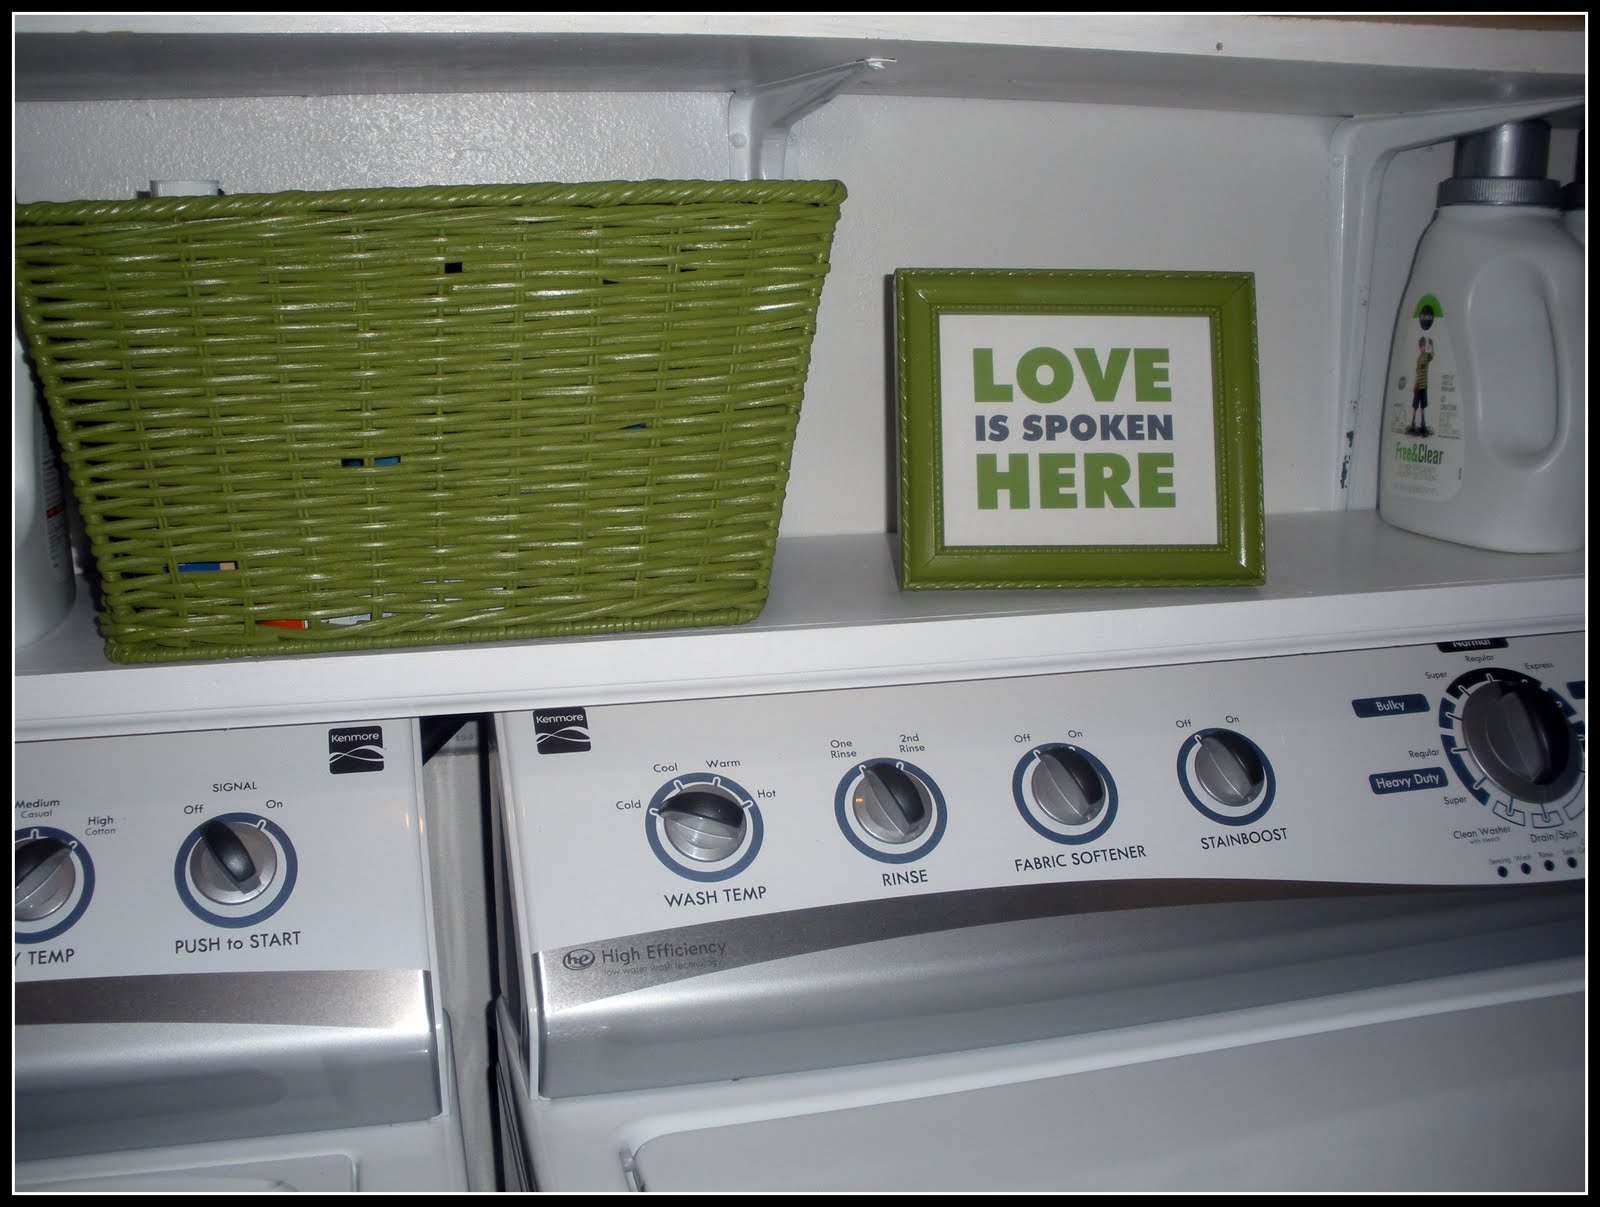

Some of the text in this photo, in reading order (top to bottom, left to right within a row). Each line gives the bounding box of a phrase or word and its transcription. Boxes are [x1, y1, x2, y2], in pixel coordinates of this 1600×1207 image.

[973, 346, 1172, 404] LOVE
[975, 414, 1174, 442] IS SPOKEN
[976, 452, 1177, 510] HERE
[1465, 655, 1494, 664] Regular
[1524, 662, 1554, 671] Express
[1425, 672, 1448, 680] Super
[1376, 700, 1405, 712] Bulky
[536, 712, 584, 724] Kenmore
[1225, 715, 1240, 724] On
[1176, 719, 1193, 729] Off
[331, 731, 380, 743] Kenmore
[900, 734, 920, 744] 2nd
[1014, 734, 1031, 744] Off
[1068, 729, 1083, 739] On
[830, 739, 853, 749] One
[900, 743, 925, 753] Rinse
[830, 749, 857, 759] Rinse
[1409, 749, 1440, 760] Regular
[653, 763, 678, 773] Cool
[706, 758, 741, 769] Warm
[1376, 772, 1439, 789] Heavy Duty
[212, 781, 258, 793] SIGNAL
[757, 789, 776, 799] Hot
[15, 799, 60, 809] Medium
[266, 800, 283, 809] On
[616, 800, 642, 811] Cold
[1444, 796, 1467, 806] Super
[21, 809, 52, 818] Casual
[184, 804, 204, 815] Off
[88, 816, 114, 827] High
[85, 827, 116, 836] Cotton
[1453, 826, 1511, 840] Clean Washer
[1200, 828, 1288, 851] STAINBOOST
[1015, 845, 1147, 872] FABRIC SOFTENER
[882, 869, 929, 887] RINSE
[664, 886, 767, 908] WASH TEMP
[175, 931, 302, 954] PUSH to START
[28, 949, 75, 966] TEMP
[602, 942, 727, 966] High Efficiency
[604, 968, 620, 977] low
[622, 966, 648, 975] water
[650, 963, 673, 972] wash
